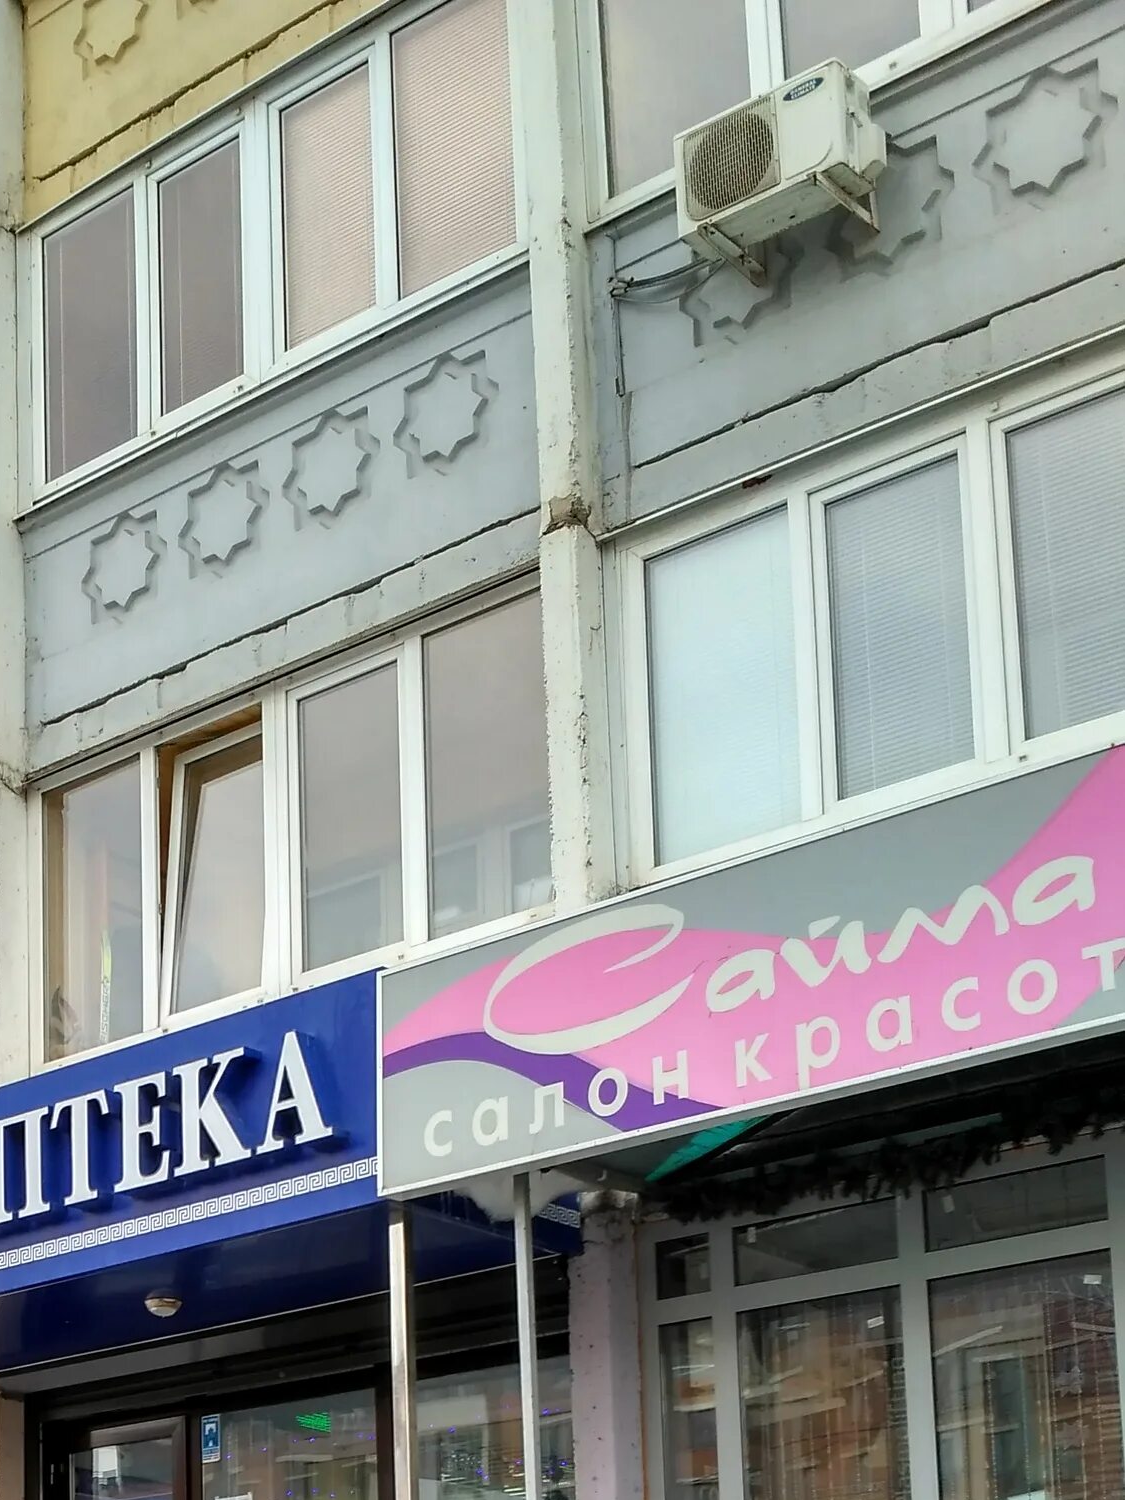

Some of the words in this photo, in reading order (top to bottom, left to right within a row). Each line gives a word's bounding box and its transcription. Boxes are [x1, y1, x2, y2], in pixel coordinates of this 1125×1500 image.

[423, 1055, 690, 1158] салон
[734, 936, 1125, 1090] красот
[483, 854, 1095, 1055] Сайма
